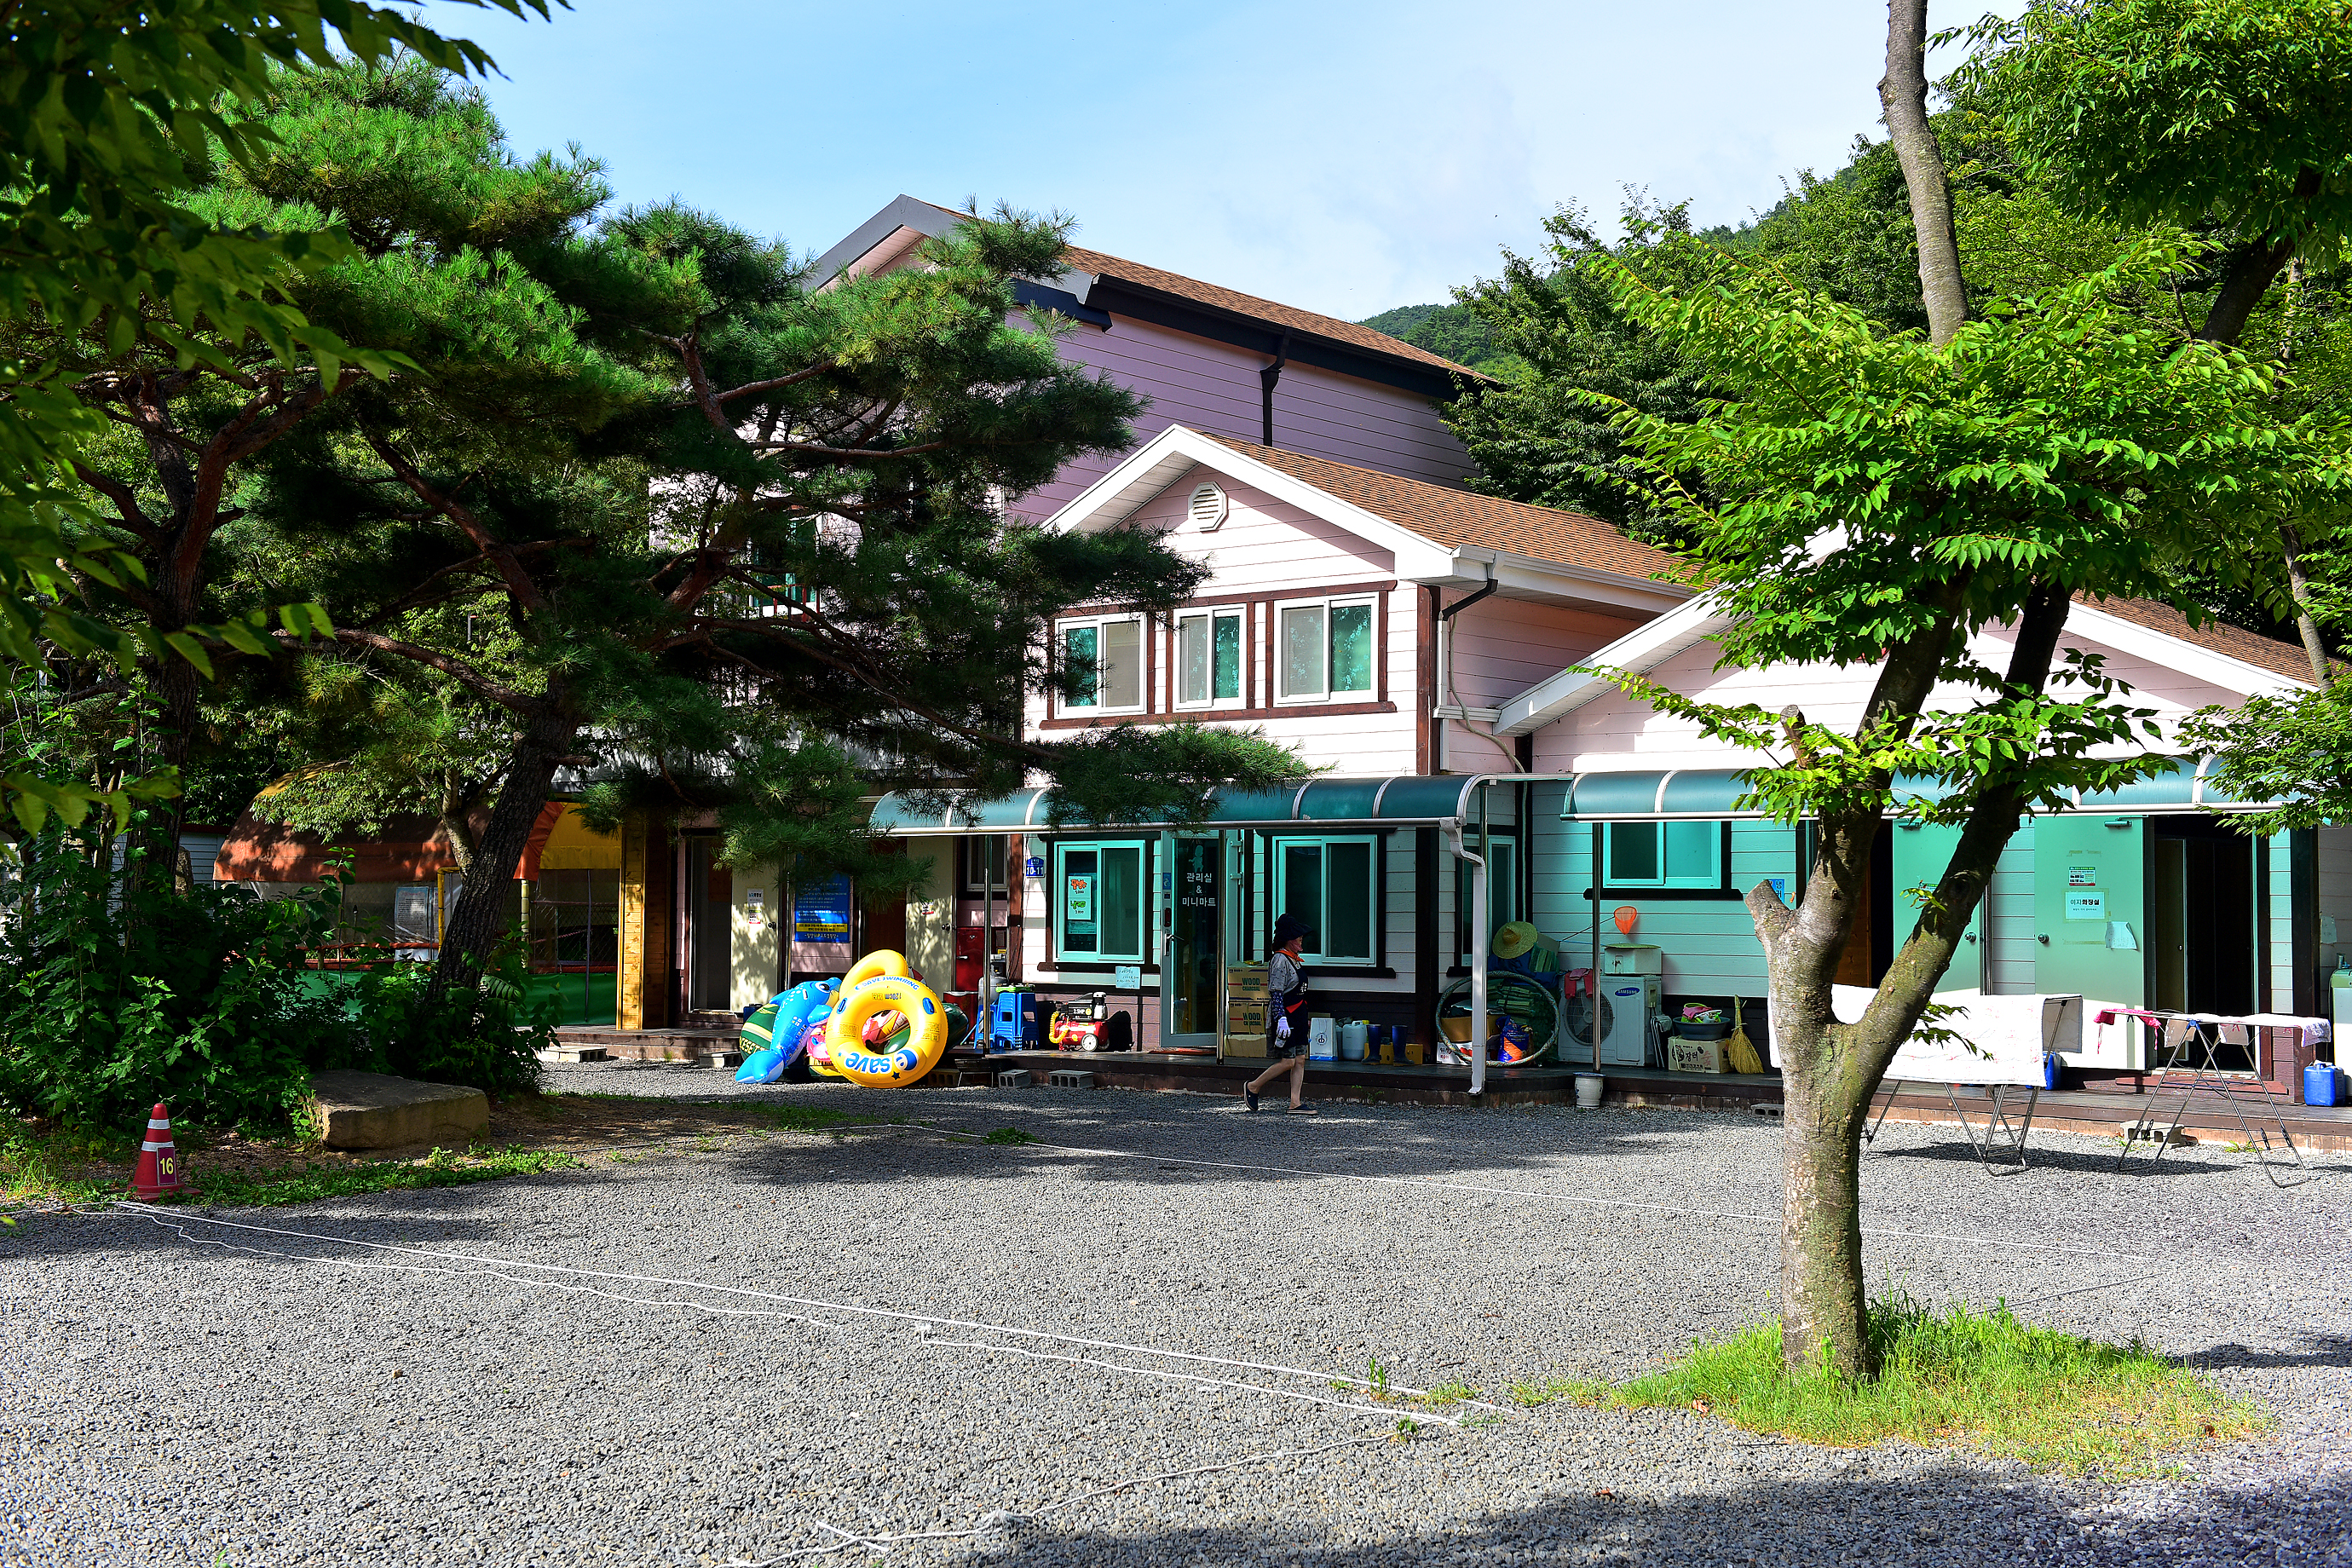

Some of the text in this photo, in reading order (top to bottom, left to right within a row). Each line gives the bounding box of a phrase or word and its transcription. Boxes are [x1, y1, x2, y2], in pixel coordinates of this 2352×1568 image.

[1026, 866, 1043, 875] 10-11
[1186, 873, 1212, 883] 관리실
[1196, 885, 1202, 894] &
[1182, 896, 1216, 907] 미니마트
[1242, 1012, 1261, 1021] WOOD
[1685, 1050, 1698, 1063] 장터
[845, 1052, 891, 1074] save
[159, 1156, 174, 1175] 16
